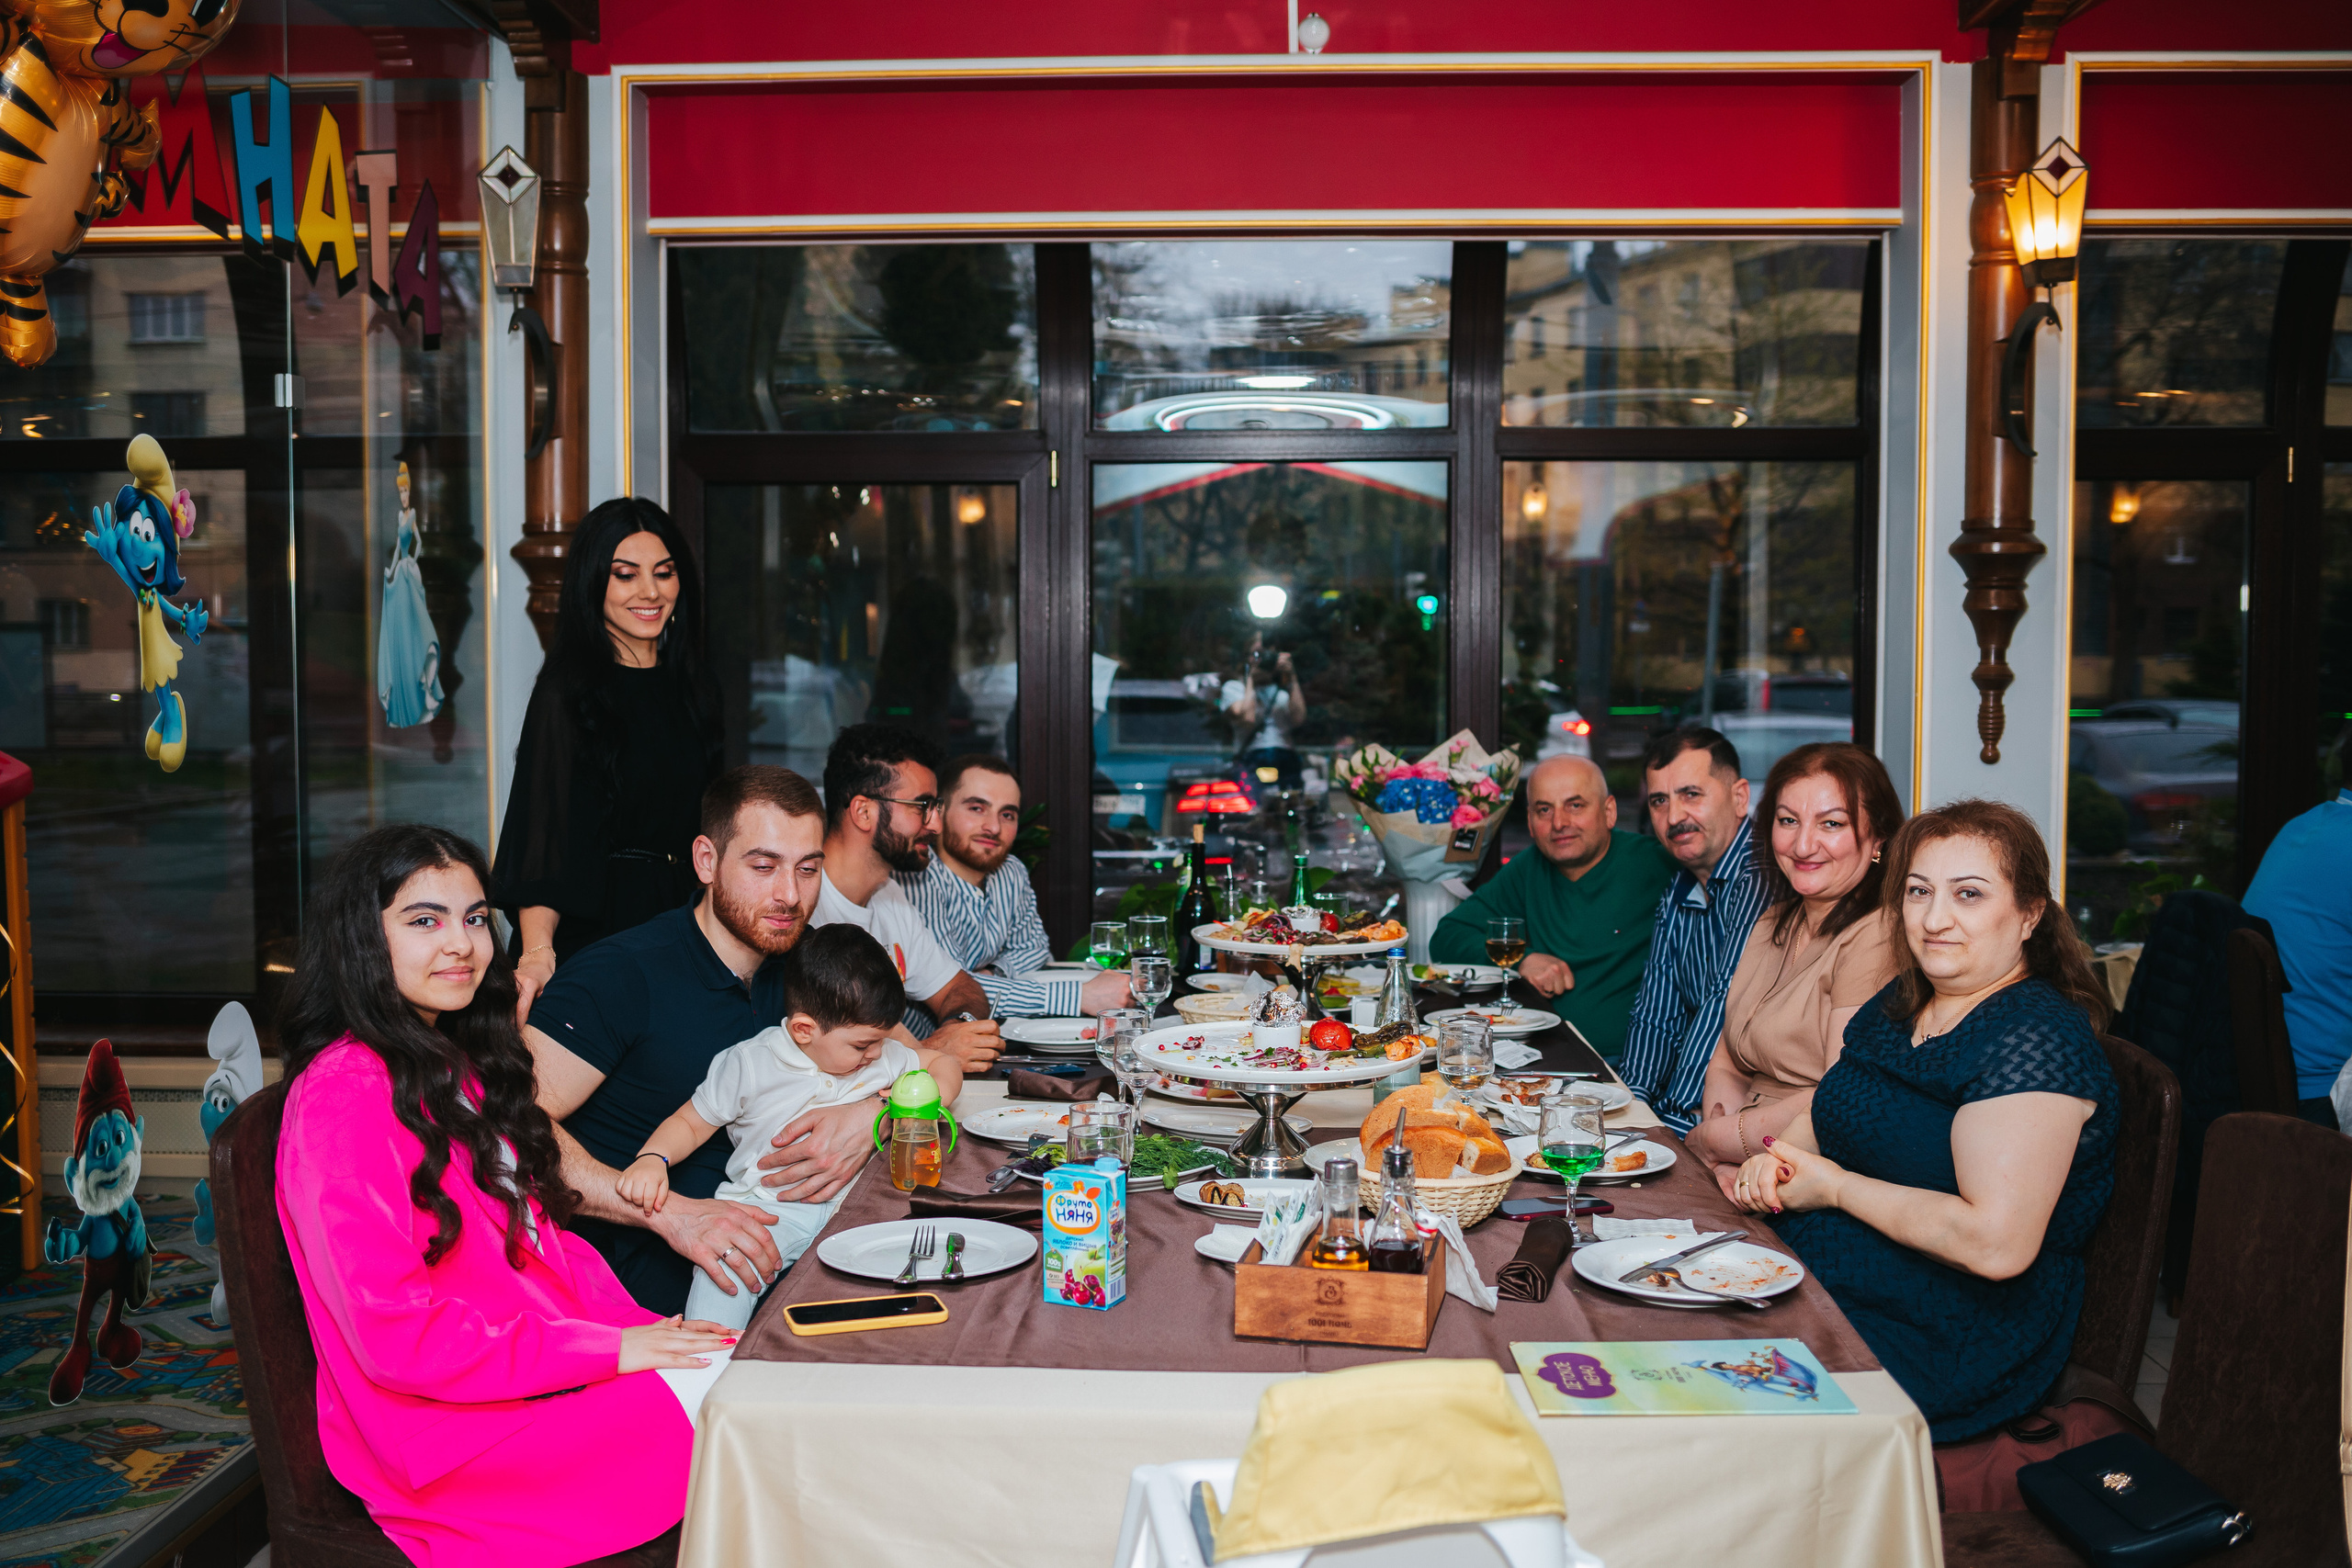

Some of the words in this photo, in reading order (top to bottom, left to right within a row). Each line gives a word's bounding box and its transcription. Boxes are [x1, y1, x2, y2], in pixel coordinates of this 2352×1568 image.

[1056, 1195, 1092, 1209] Фруто
[1056, 1208, 1093, 1224] НЯНЯ
[1047, 1258, 1061, 1268] 100%
[1578, 1365, 1604, 1387] МЕНЮ
